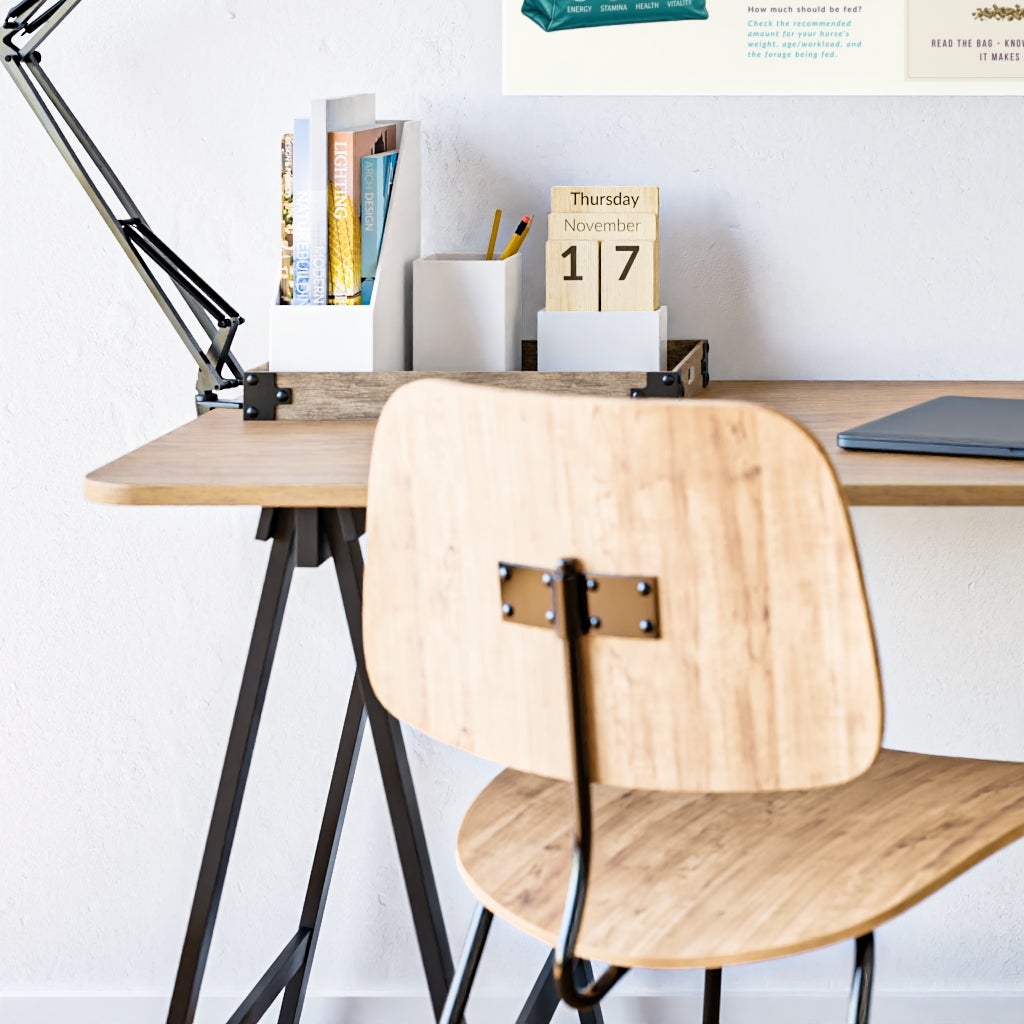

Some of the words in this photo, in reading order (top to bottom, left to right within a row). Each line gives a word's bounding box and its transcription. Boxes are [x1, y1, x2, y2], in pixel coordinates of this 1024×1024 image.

[636, 2, 659, 10] HEALTH
[667, 0, 692, 8] VITALITY
[932, 39, 953, 47] READ
[958, 39, 972, 47] THE
[977, 39, 992, 47] BAG
[980, 53, 987, 61] IT
[992, 53, 1019, 61] MAKES
[334, 141, 348, 220] LIGHTING
[365, 161, 374, 189] ARCH
[570, 192, 639, 208] Thursday
[365, 192, 374, 231] DESIGN
[565, 218, 642, 232] November
